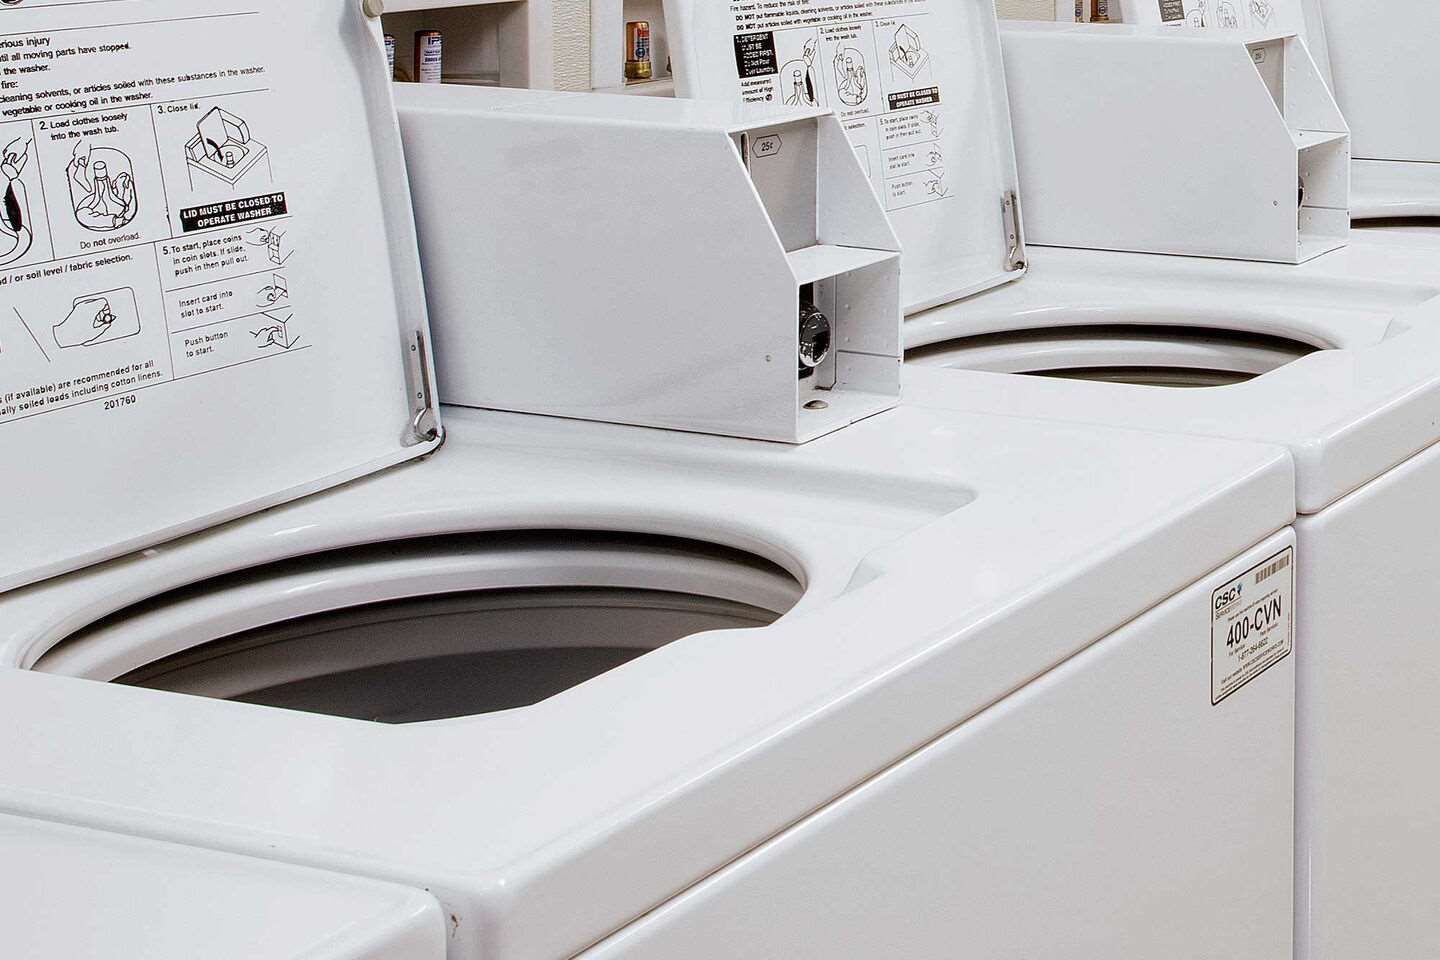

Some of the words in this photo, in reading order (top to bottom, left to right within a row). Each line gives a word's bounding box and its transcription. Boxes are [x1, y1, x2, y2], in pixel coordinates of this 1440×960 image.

[26, 36, 50, 47] injury
[24, 51, 53, 59] moving
[56, 48, 75, 57] parts
[78, 45, 96, 54] have
[1, 81, 18, 89] fire:
[84, 84, 111, 93] articles
[2, 105, 42, 117] vegetable
[56, 100, 87, 109] cooking
[50, 120, 70, 129] Load
[72, 116, 99, 126] clothes
[101, 113, 128, 122] loosely
[51, 132, 66, 141] into
[69, 130, 80, 138] the
[183, 209, 197, 218] LID
[199, 206, 223, 217] MUST
[225, 202, 236, 211] BE
[239, 198, 269, 209] CLOSED
[272, 194, 283, 202] TO
[197, 215, 236, 227] OPERATE
[237, 208, 272, 220] WASHER
[80, 241, 91, 249] Do
[203, 239, 225, 249] place
[227, 234, 242, 244] coins
[26, 270, 41, 279] soil
[44, 266, 62, 277] level
[70, 260, 93, 271] fabric
[175, 266, 193, 276] push
[204, 262, 219, 271] then
[179, 297, 200, 308] Insert
[202, 294, 218, 303] card
[220, 290, 232, 298] into
[185, 338, 203, 347] Push
[206, 331, 228, 343] button
[16, 383, 56, 398] available)
[58, 380, 71, 389] are
[73, 365, 129, 386] recommended
[132, 363, 142, 372] for
[19, 399, 44, 410] soiled
[46, 393, 69, 404] loads
[72, 383, 109, 398] including
[111, 376, 135, 389] cotton
[104, 395, 136, 410] 201760
[1216, 588, 1235, 609] CSC
[1227, 595, 1281, 648] 400-CVN
